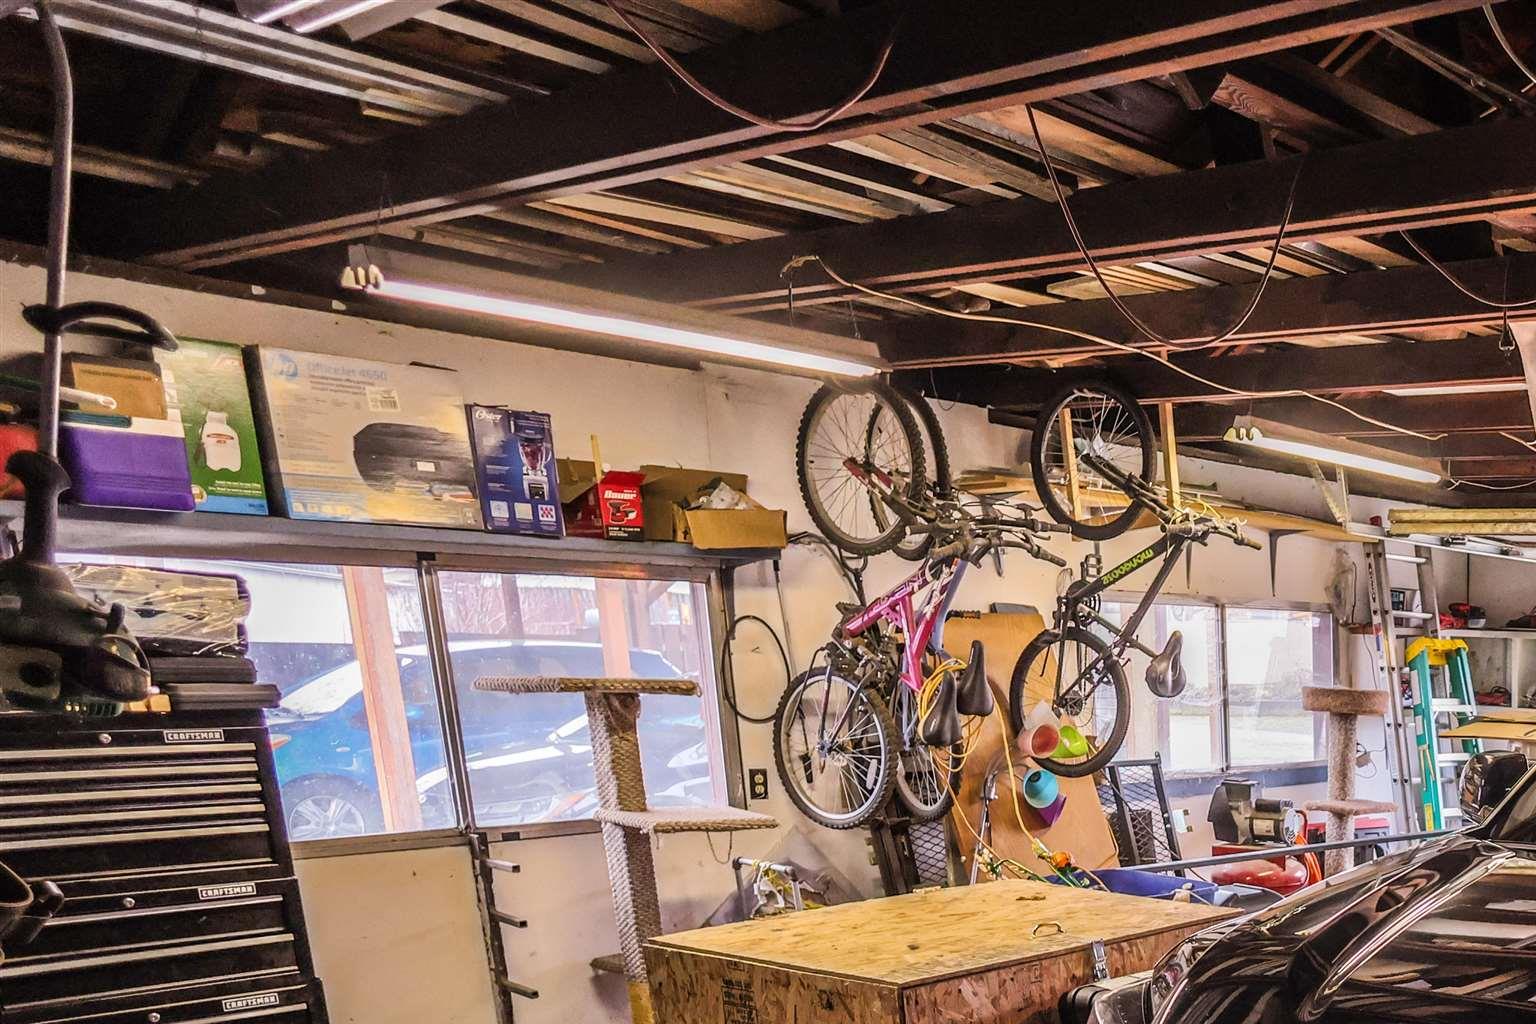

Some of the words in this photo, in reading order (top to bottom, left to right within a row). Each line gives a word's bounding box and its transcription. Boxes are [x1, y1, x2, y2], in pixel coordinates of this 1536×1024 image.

[604, 490, 637, 500] Bauer
[167, 731, 221, 741] CRAFTSMAN
[202, 884, 254, 898] CRAFTSMAN
[225, 994, 277, 1009] CRAFTSMAN
